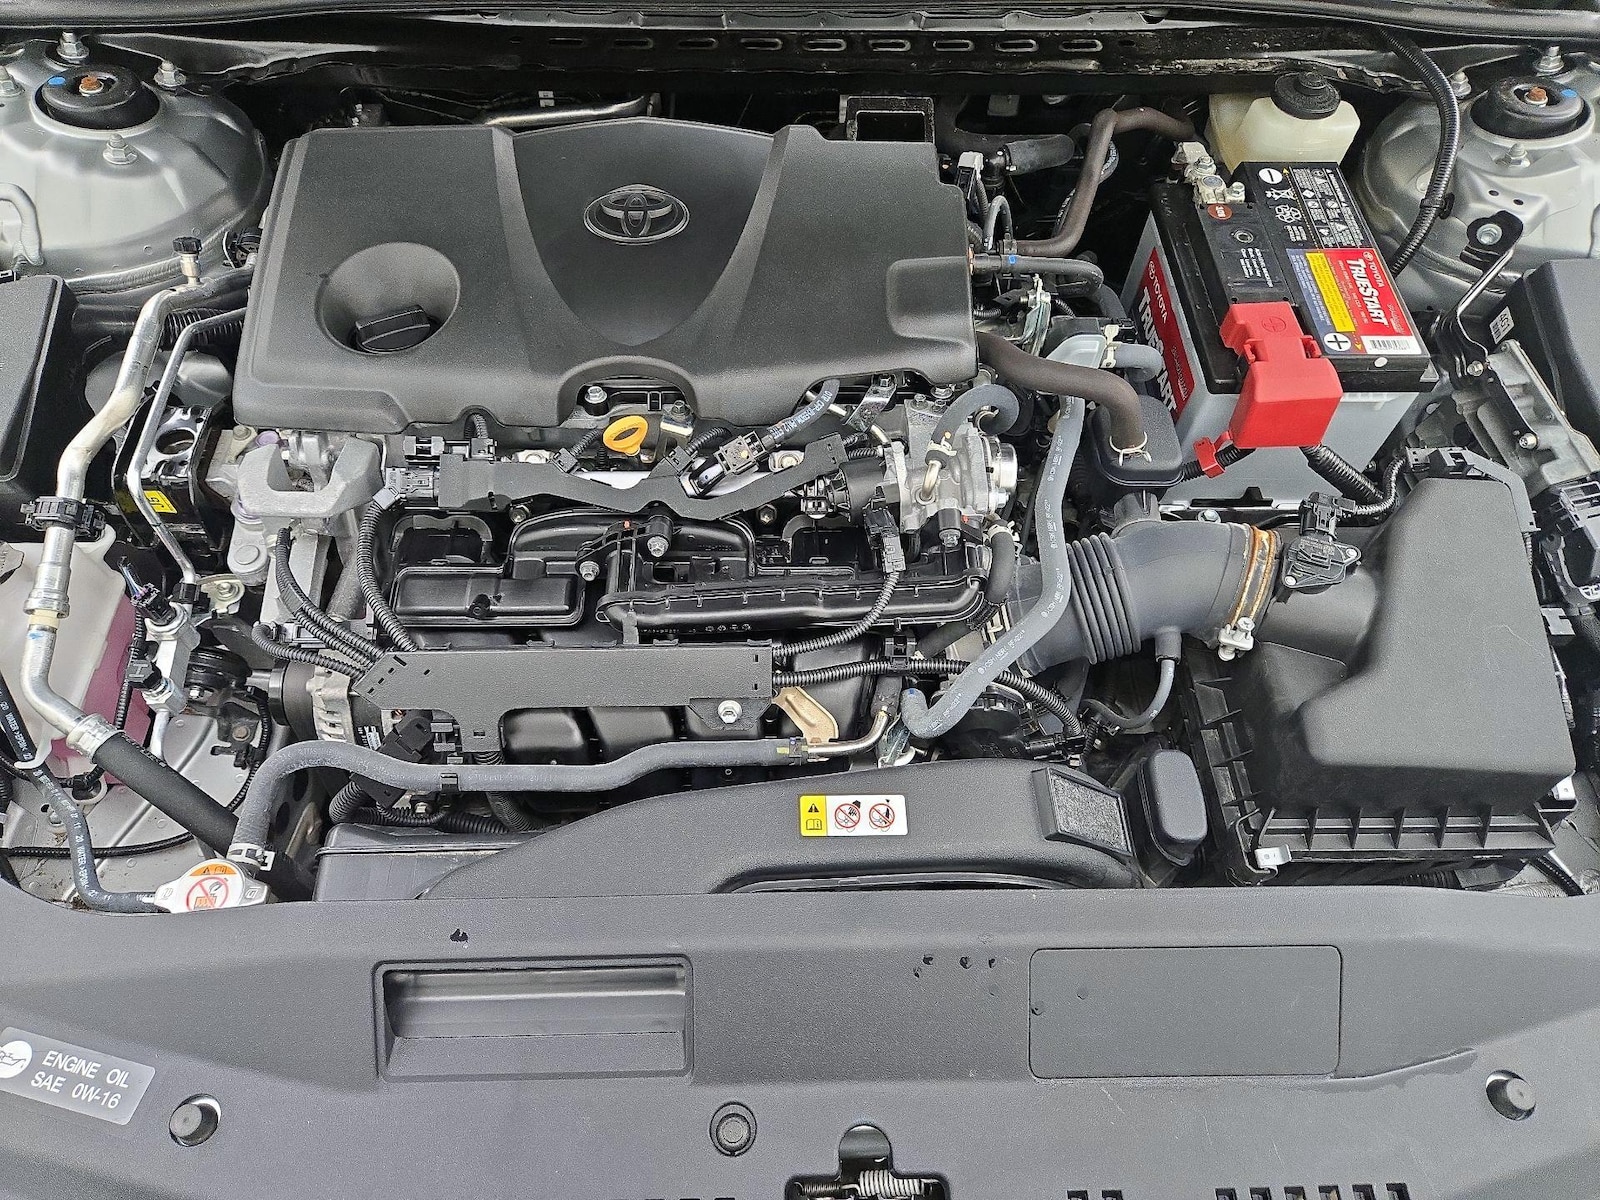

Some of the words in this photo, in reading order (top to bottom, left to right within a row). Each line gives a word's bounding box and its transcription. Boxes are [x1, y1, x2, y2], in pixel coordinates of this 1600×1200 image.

[1346, 258, 1388, 325] TRUESTART
[1368, 260, 1385, 288] TOYOTA
[1152, 278, 1167, 324] TOYOTA
[42, 1050, 101, 1079] ENGINE
[106, 1068, 130, 1088] OIL
[31, 1071, 66, 1093] SAE
[71, 1083, 122, 1109] 0W-16
